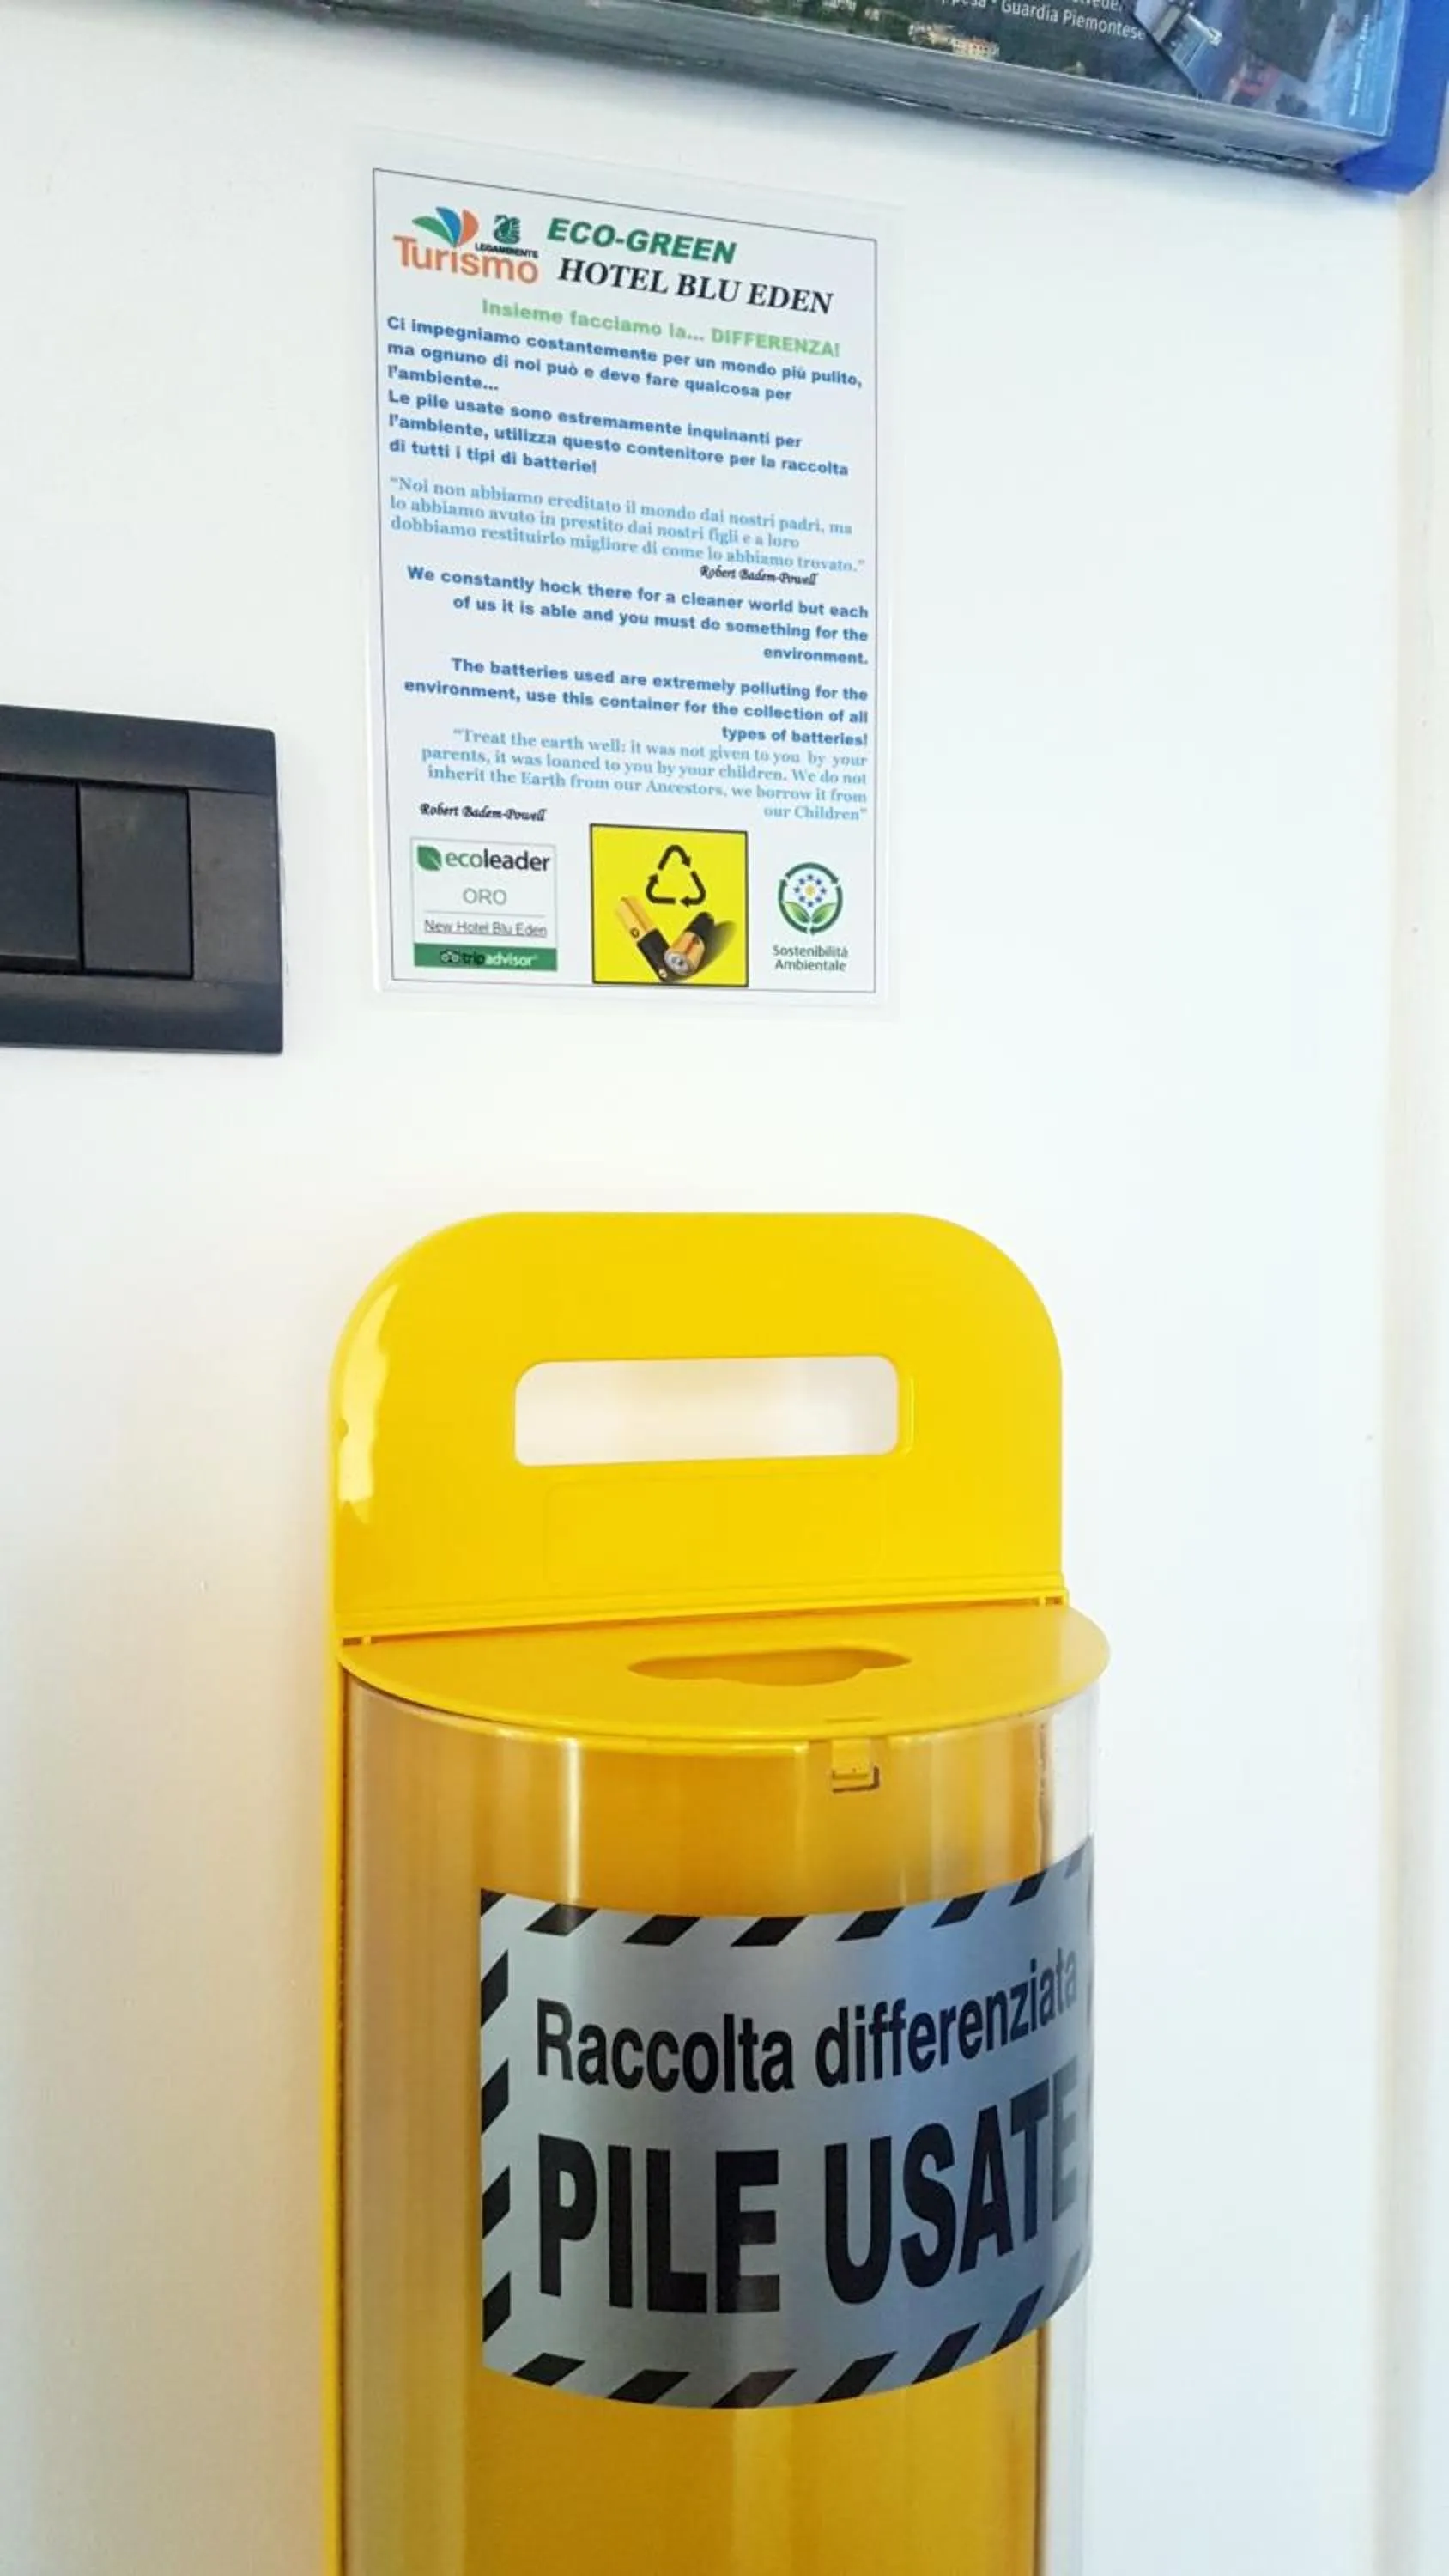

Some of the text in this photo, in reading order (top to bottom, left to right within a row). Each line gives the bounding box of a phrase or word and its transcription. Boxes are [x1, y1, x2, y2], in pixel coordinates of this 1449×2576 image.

[1001, 0, 1058, 23] Guardia
[1063, 10, 1146, 41] Piemontese
[392, 234, 538, 284] Turismo
[475, 242, 539, 258] LEGAMBIENTE
[547, 216, 737, 264] ECO-GREEN
[557, 258, 834, 313] HOTEL BLU EDEN
[482, 299, 840, 356] Insieme facciamo la... DIFFERENZA!
[386, 316, 862, 388] Ci impegniamo costantemente per un mondo più pulito,
[387, 343, 792, 401] ma ognuno di noi può deve fare qualcosa per
[388, 389, 802, 448] Le pile usate sono estremamente inquinanti per
[389, 439, 597, 474] di tutti tipi di batterie!
[494, 427, 557, 446] utilizza
[561, 436, 621, 452] questo
[626, 443, 724, 463] contenitore
[729, 454, 757, 467] per
[761, 454, 776, 468] la
[781, 459, 848, 476] raccolta
[433, 484, 467, 497] non
[470, 486, 543, 504] abbiamo
[625, 500, 636, 514] il
[640, 505, 697, 519] mondo
[700, 507, 724, 522] dai
[728, 513, 775, 527] nostri
[778, 517, 824, 533] padri,
[828, 523, 852, 534] ma
[391, 516, 476, 537] dobbiamo
[480, 527, 567, 545] restituirlo
[569, 534, 639, 553] migliore
[640, 540, 658, 553] di
[659, 546, 705, 557] come
[706, 544, 724, 559] lo
[724, 544, 794, 565] abbiamo
[407, 565, 869, 618] We constantly hock there for cleaner world but each
[699, 564, 737, 579] Robert
[452, 596, 869, 641] of us it is able and you must do something for the
[762, 647, 868, 664] environment.
[451, 658, 868, 701] The batteries used are extremely polluting for the
[403, 680, 868, 723] environment, use this container for the collection of all
[510, 732, 539, 747] the
[540, 736, 584, 750] earth
[630, 739, 641, 754] it
[646, 744, 676, 756] was
[678, 746, 706, 757] not
[707, 744, 752, 761] given
[751, 749, 771, 761] to
[773, 751, 800, 764] you
[807, 750, 826, 767] by
[833, 756, 868, 768] your
[721, 726, 868, 745] types of batteries!
[427, 765, 867, 803] inherit the Earth from our Ancestors, we borrow it from
[419, 803, 459, 816] Robert
[763, 807, 791, 818] our
[446, 848, 550, 872] ecoleader
[463, 887, 507, 905] ORO
[424, 920, 548, 938] New Hotel Blu Eden
[775, 959, 847, 971] Ambientale
[537, 1947, 1077, 2093] Raccolta differenziata
[538, 2055, 1077, 2314] PILE USATE
